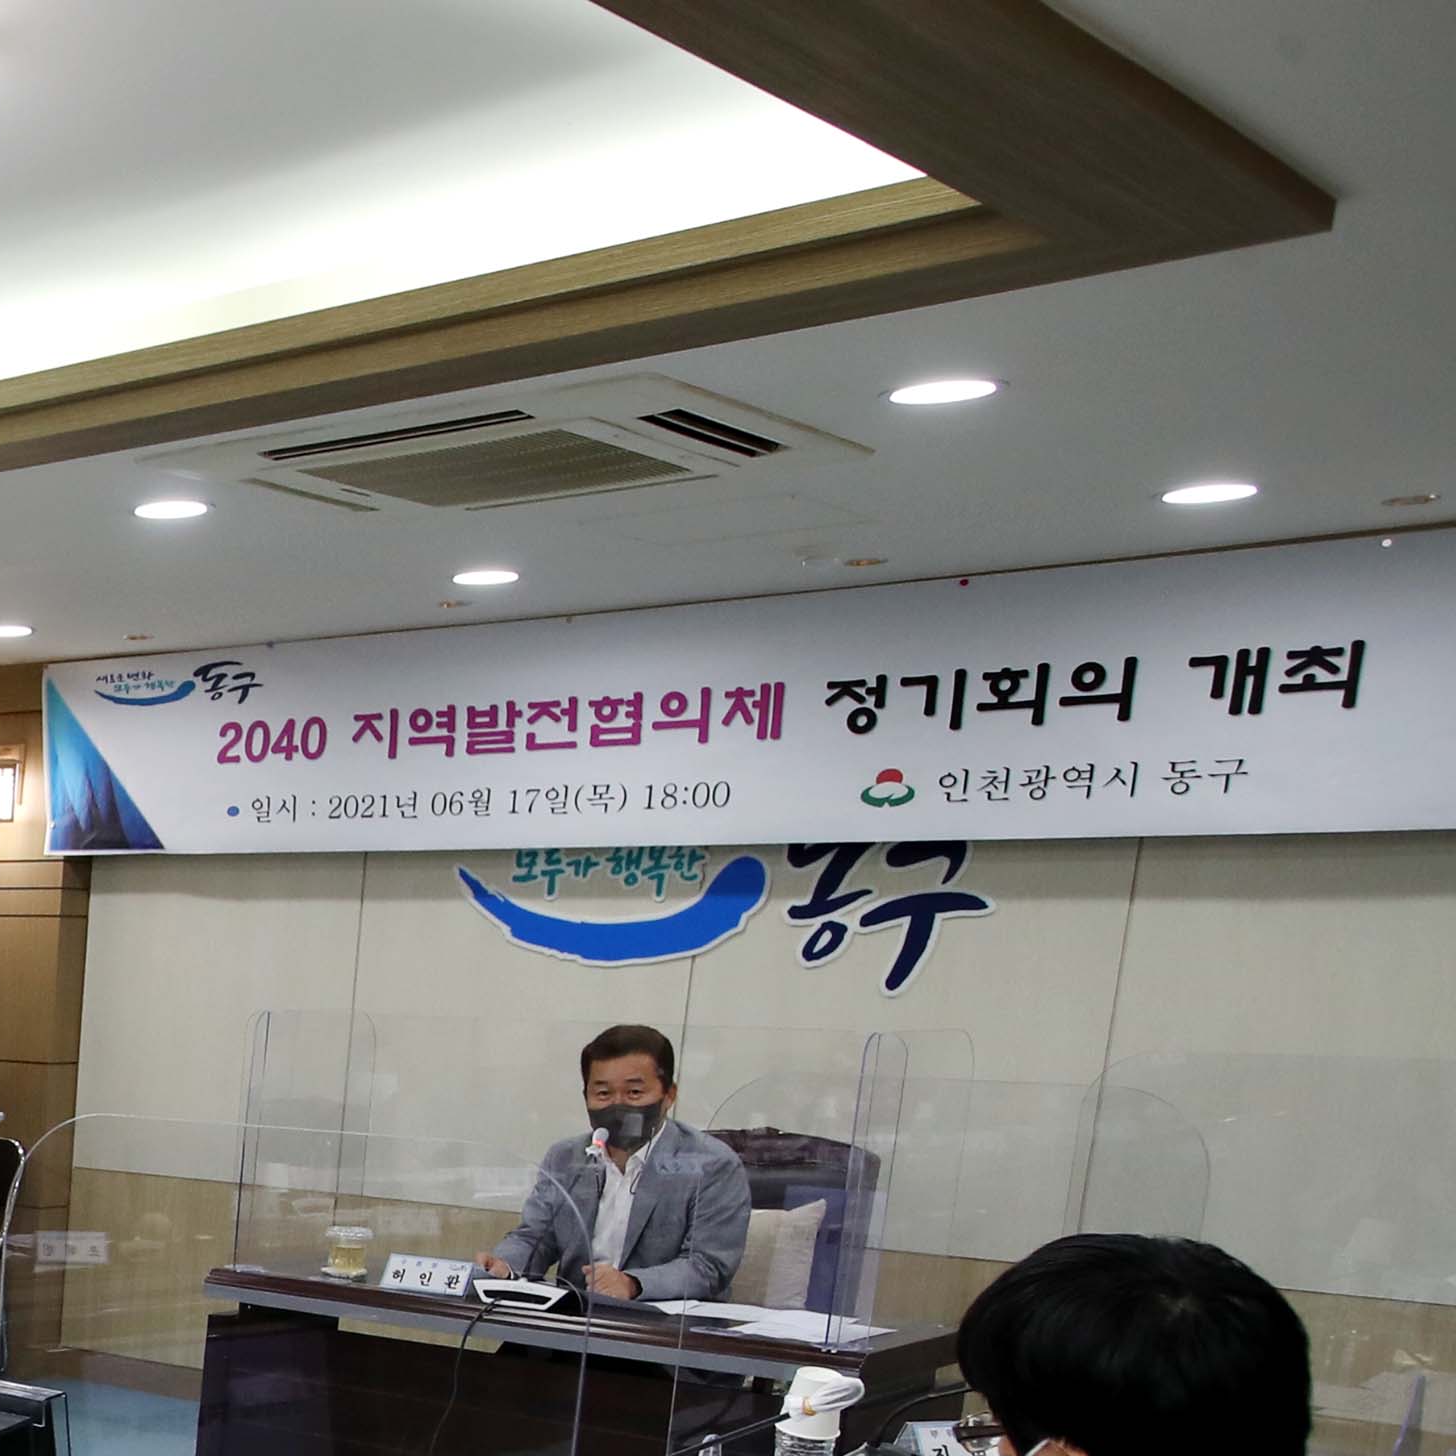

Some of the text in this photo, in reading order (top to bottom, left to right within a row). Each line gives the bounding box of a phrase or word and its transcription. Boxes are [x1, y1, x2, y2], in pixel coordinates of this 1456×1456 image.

[193, 661, 264, 704] 동구
[216, 639, 1366, 764] 2040 지역발전협의체 정기회의 개최
[250, 791, 299, 824] 일시
[328, 789, 419, 821] 2021년
[431, 787, 492, 818] 06월
[507, 781, 628, 816] 17일(목)
[644, 780, 731, 810] 18:00
[937, 757, 1248, 804] 인천광역시 동구
[512, 847, 600, 896] 모두가
